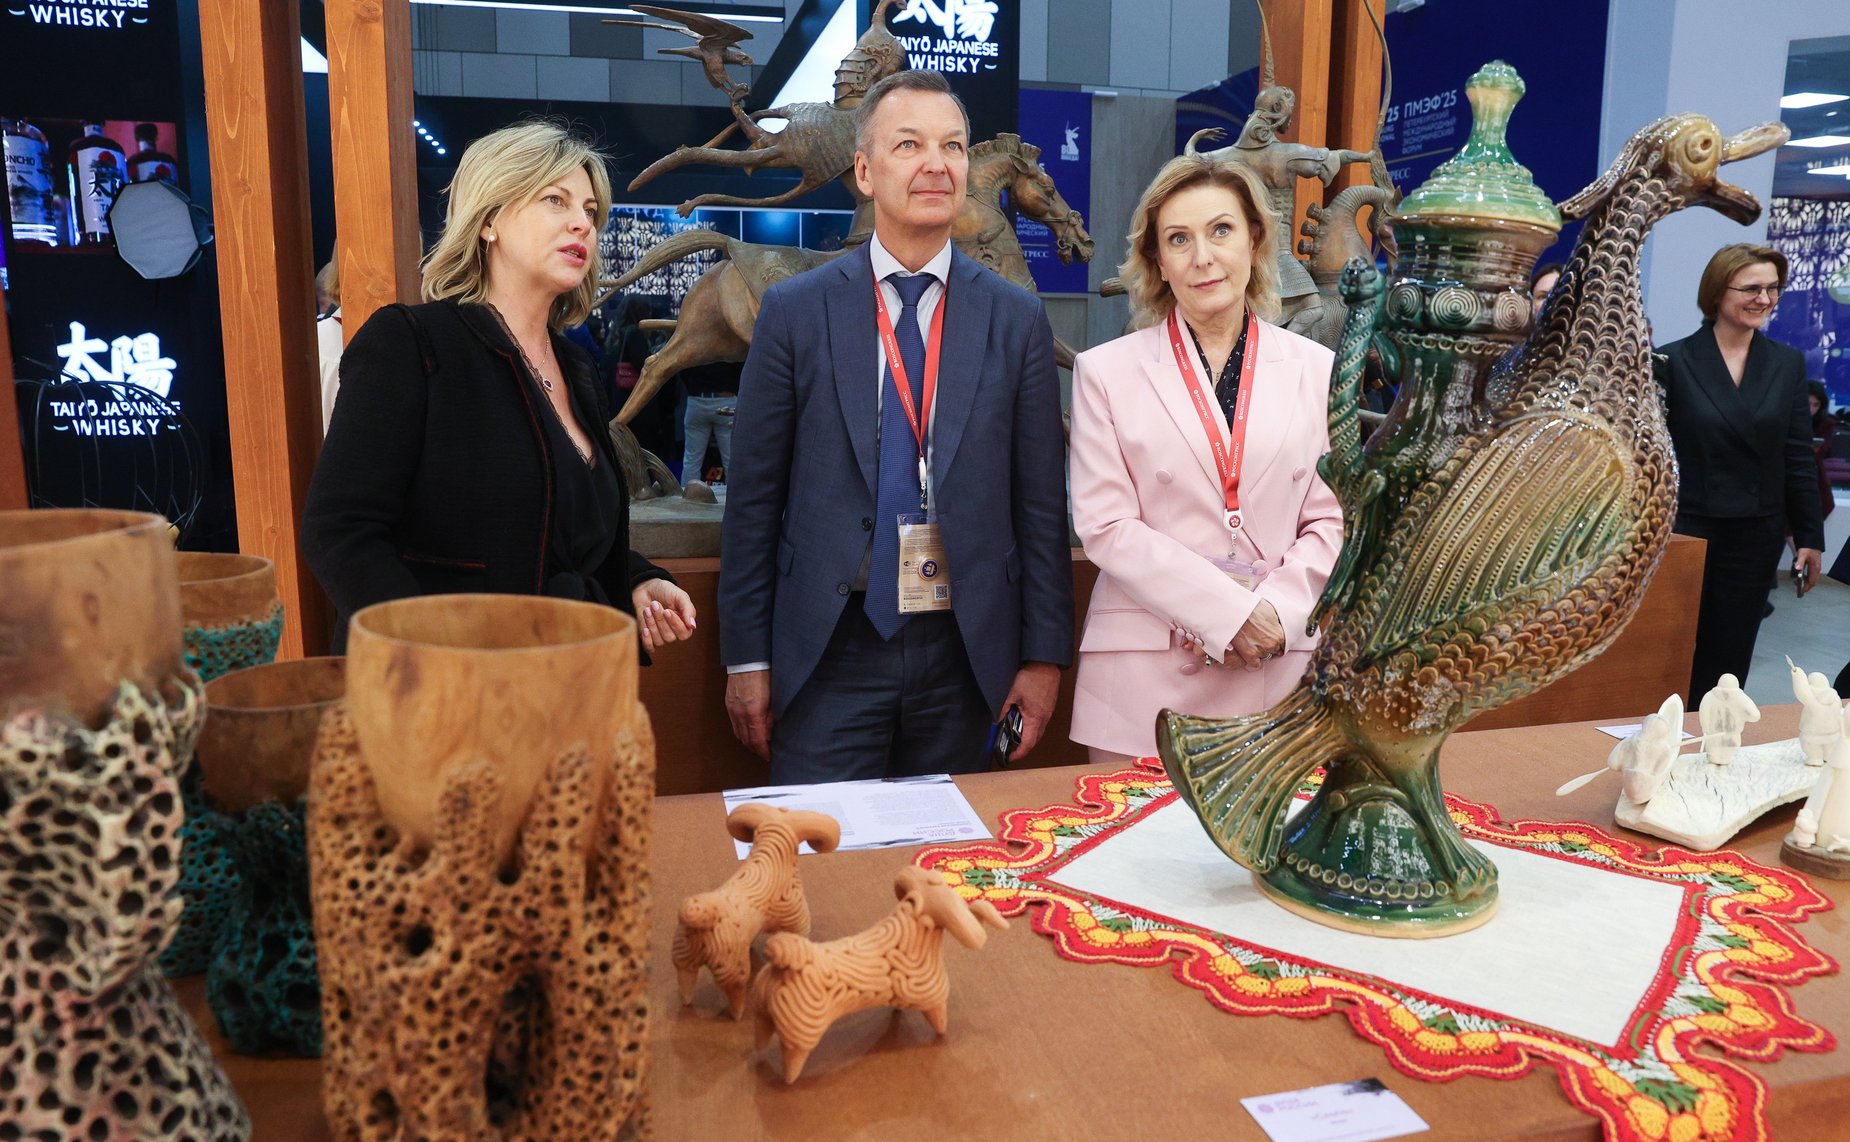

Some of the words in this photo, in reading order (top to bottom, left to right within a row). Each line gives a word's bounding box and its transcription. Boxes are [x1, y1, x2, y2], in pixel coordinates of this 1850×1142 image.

[29, 4, 125, 28] WHISKY
[933, 39, 999, 57] JAPANESE
[908, 53, 980, 74] WHISKY
[51, 321, 178, 401] 太陽
[72, 418, 160, 436] WHISKY
